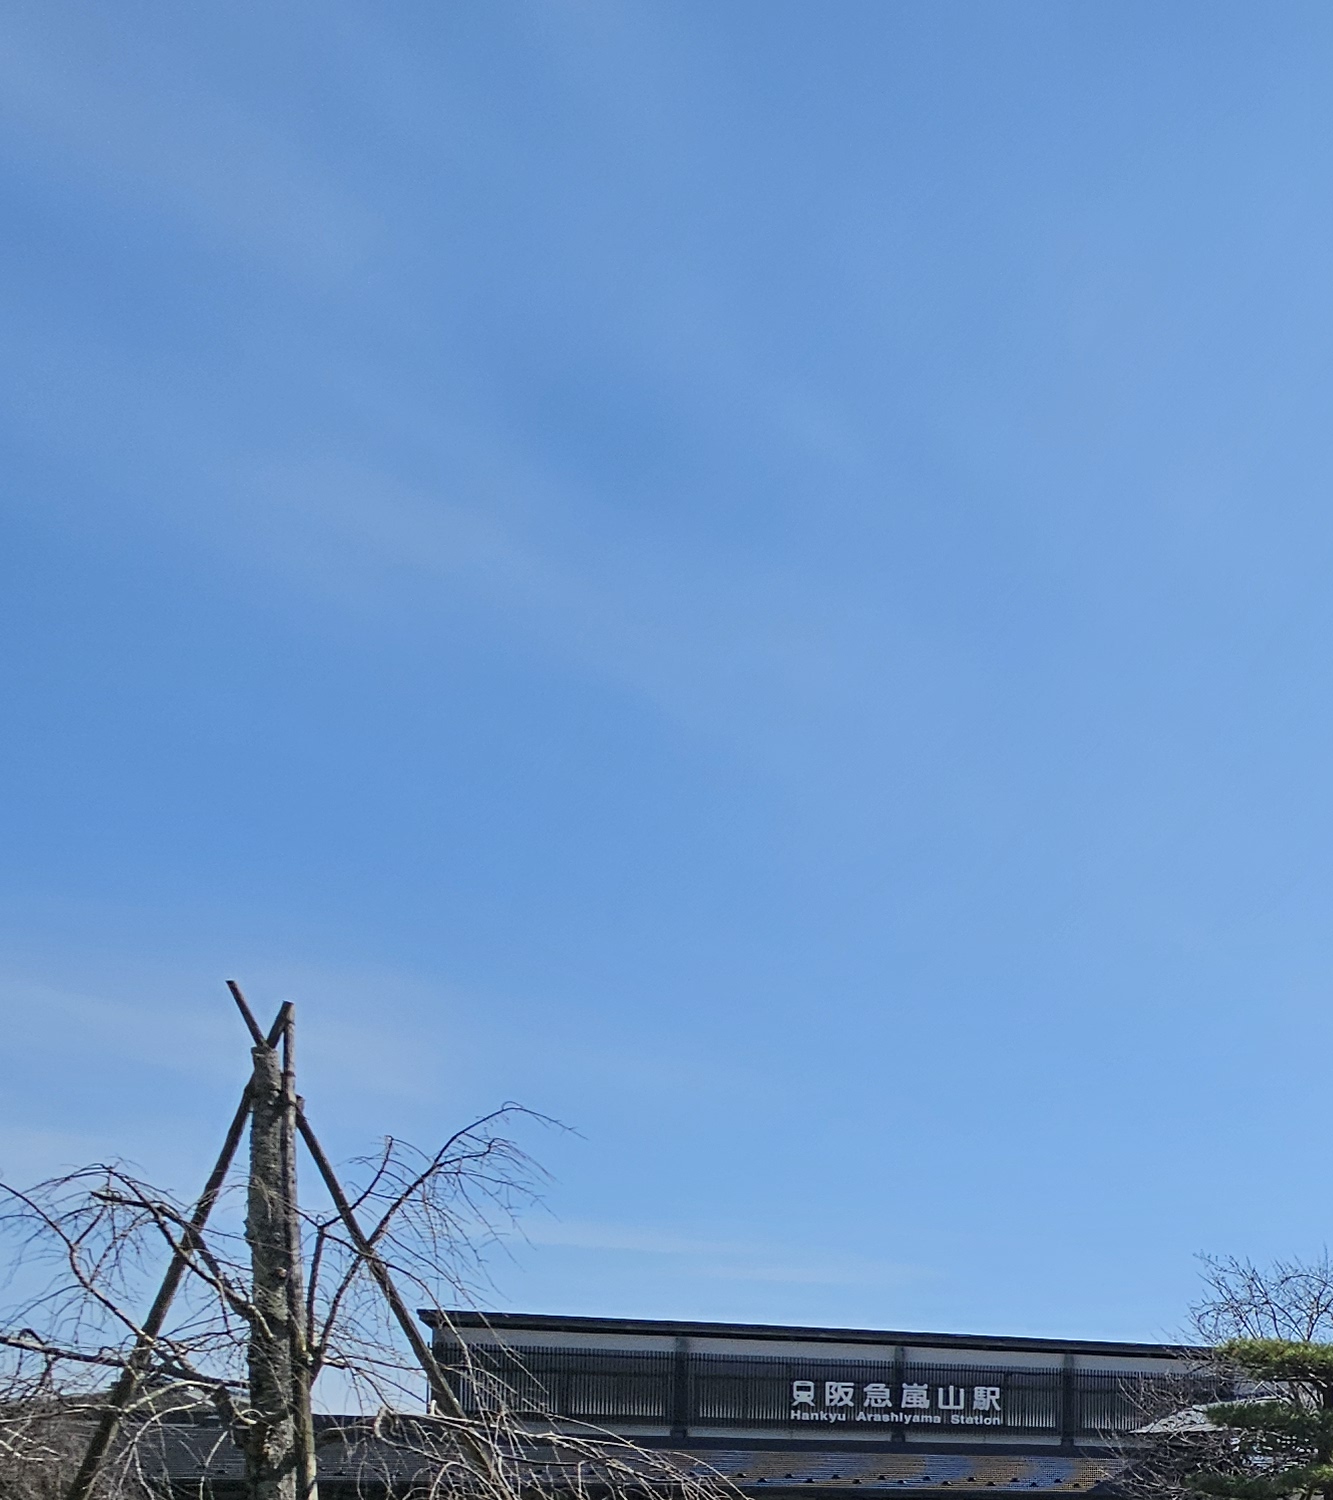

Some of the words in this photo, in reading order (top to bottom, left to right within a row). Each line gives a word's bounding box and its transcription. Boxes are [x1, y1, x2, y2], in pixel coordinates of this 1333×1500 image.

[825, 1382, 1001, 1411] 阪急嵐山駅
[790, 1410, 846, 1423] Hankyu
[855, 1412, 942, 1425] Arashiyama
[950, 1414, 1001, 1426] Station
